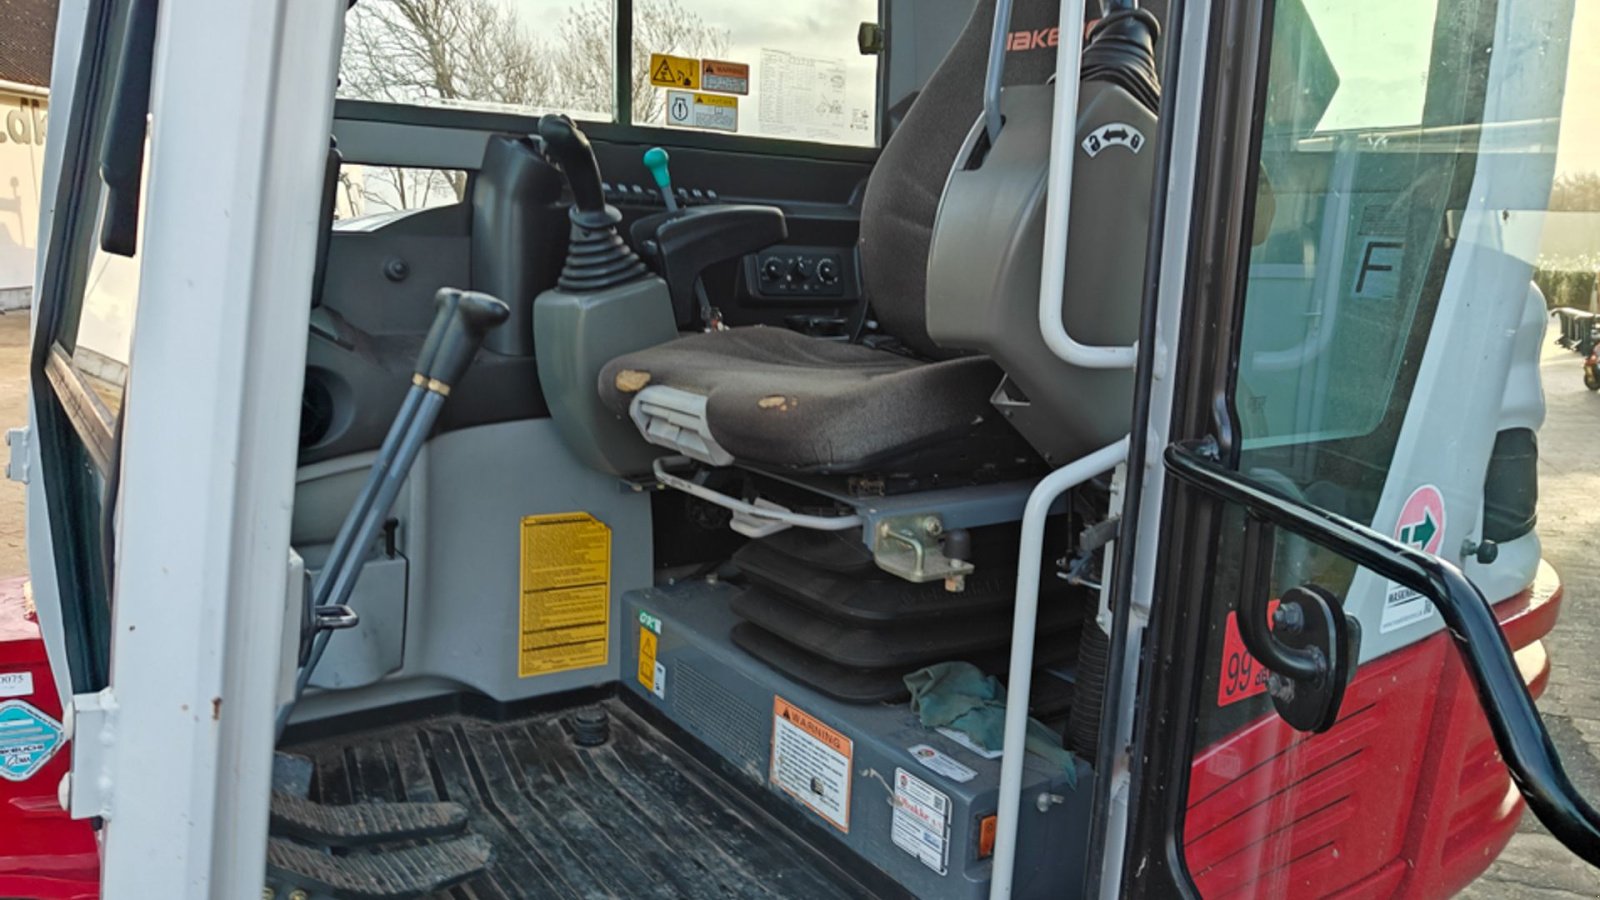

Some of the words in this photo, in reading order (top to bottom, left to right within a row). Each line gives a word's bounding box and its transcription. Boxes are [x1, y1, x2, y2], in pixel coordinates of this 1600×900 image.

[1355, 241, 1406, 293] F
[1226, 649, 1252, 696] 99
[791, 711, 841, 750] WARNING
